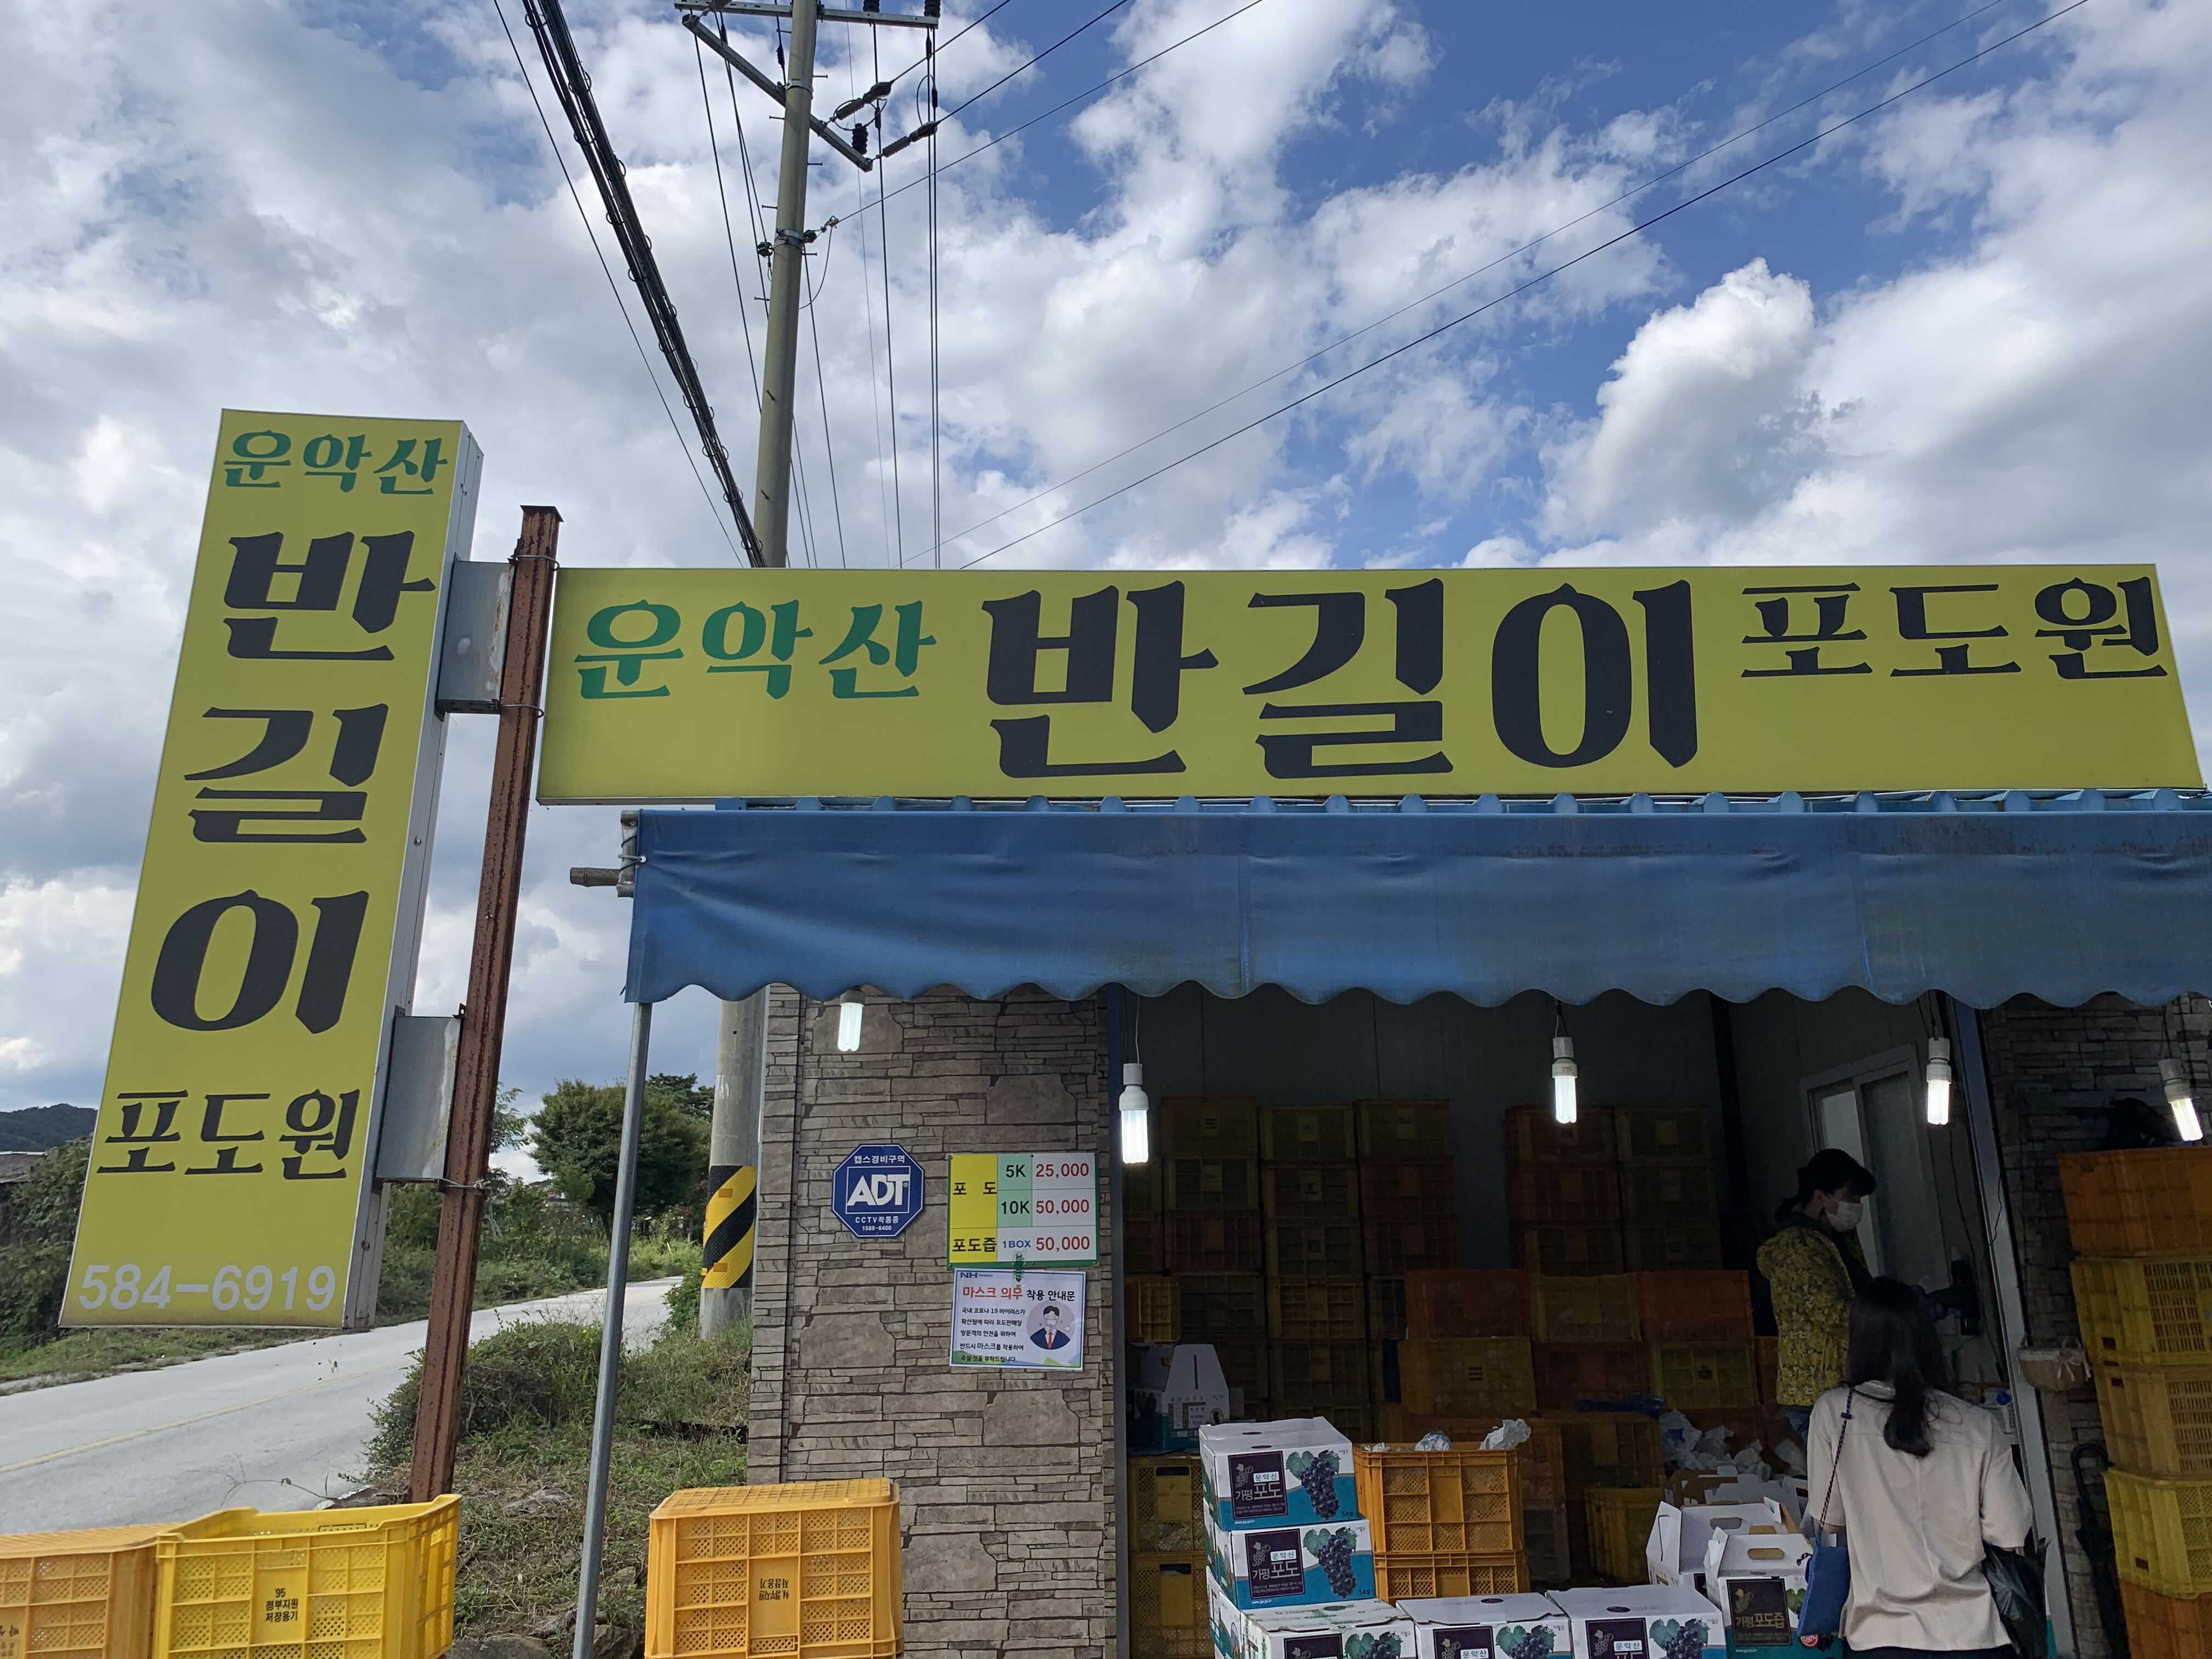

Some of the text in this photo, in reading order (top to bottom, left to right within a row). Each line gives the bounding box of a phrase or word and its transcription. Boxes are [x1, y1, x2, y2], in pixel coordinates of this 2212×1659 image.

[223, 430, 448, 495] 운악산
[573, 577, 2169, 779] 운악산 반길이 포도원
[150, 530, 437, 1035] 반길이
[96, 1088, 360, 1181] 포도원
[854, 1155, 905, 1164] 캡스경비구역
[1005, 1163, 1090, 1179] 5K 25,000
[847, 1174, 910, 1206] ADT
[1001, 1199, 1090, 1215] 10K 50,000
[855, 1216, 899, 1224] CCTV작동중
[952, 1237, 997, 1252] 포도즙
[1035, 1236, 1090, 1252] 50,000
[78, 1263, 336, 1312] 584-6919
[962, 1286, 1076, 1301] 마스크 의무 착용 안내문
[977, 1342, 1001, 1351] 마스크를
[1254, 1473, 1278, 1482] 운악산
[1272, 1551, 1295, 1560] 운악산
[760, 1578, 789, 1589] 저장용기
[264, 1610, 298, 1623] 저장용기
[1615, 1642, 1640, 1651] 운악산
[1462, 1650, 1488, 1659] 운악산
